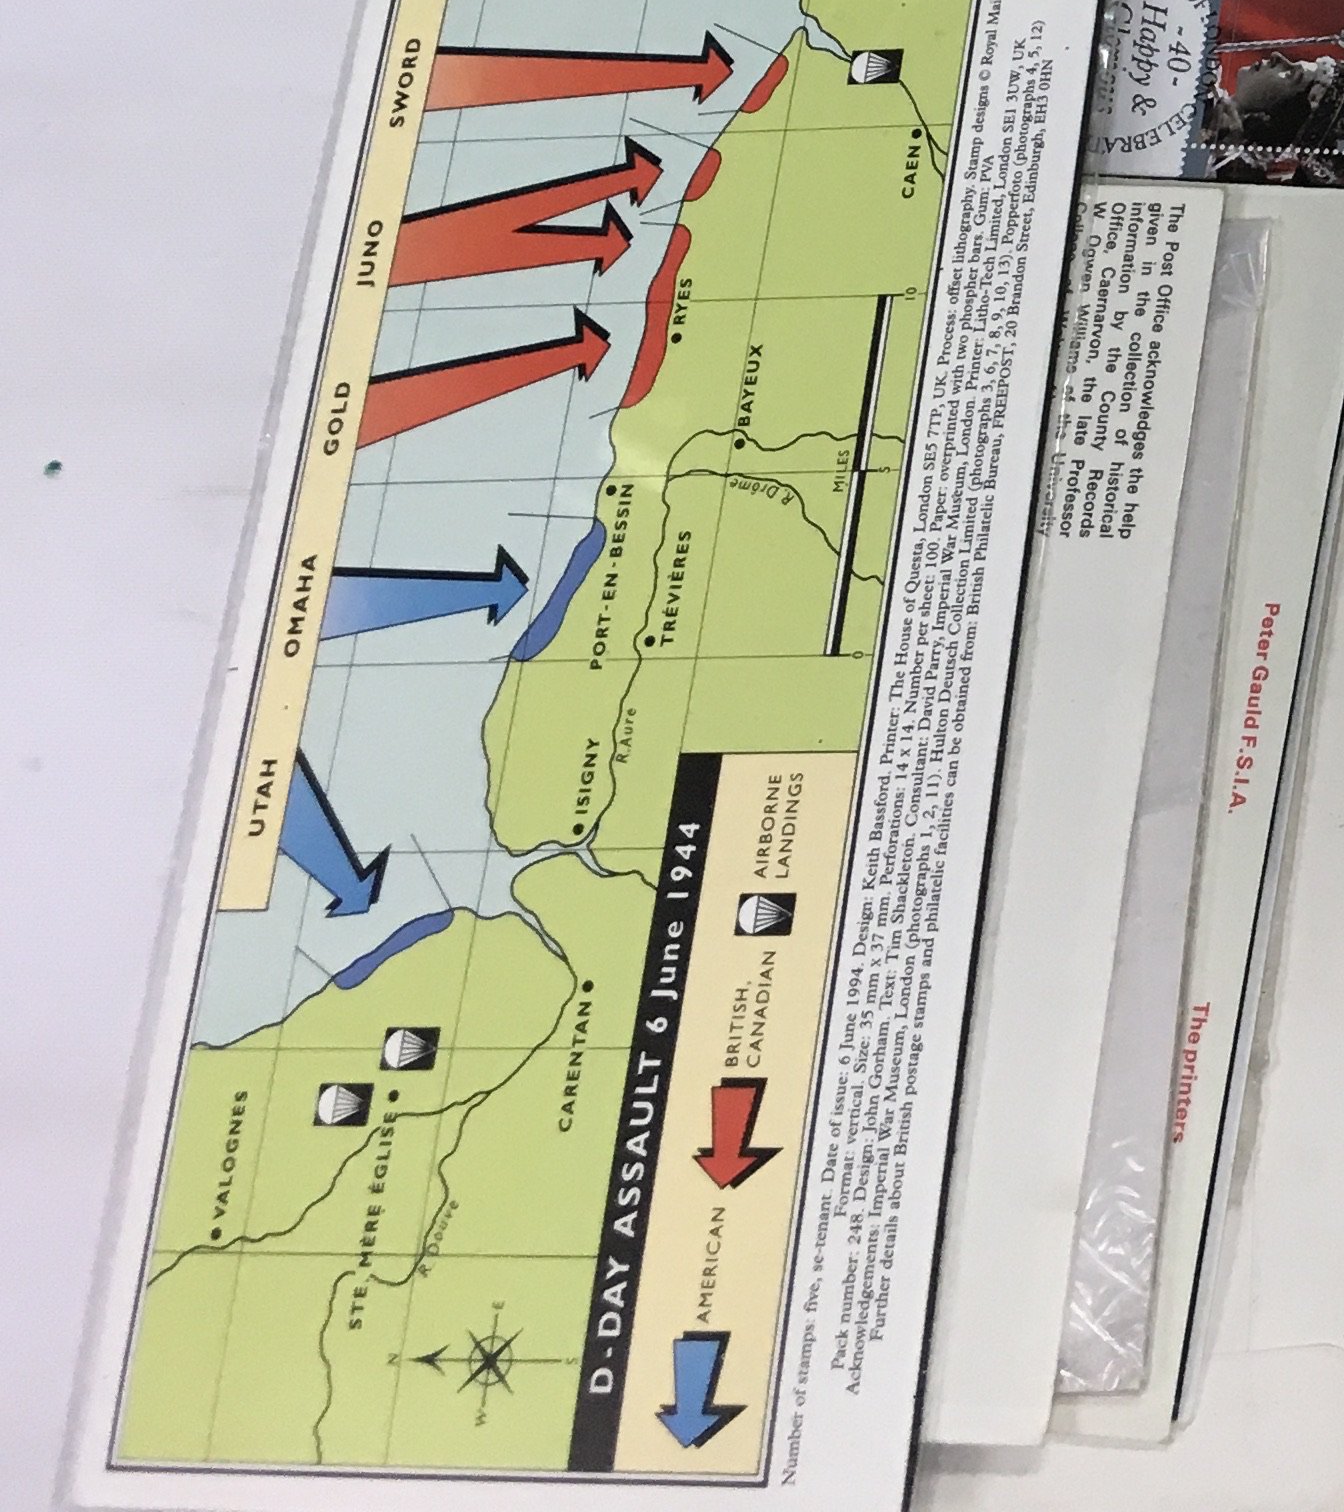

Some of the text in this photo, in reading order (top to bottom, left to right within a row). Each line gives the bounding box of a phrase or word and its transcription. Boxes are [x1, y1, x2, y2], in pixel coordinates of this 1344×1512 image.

[389, 38, 421, 128] SWORD
[901, 145, 921, 198] CAEN
[356, 219, 384, 287] JUNO
[672, 277, 692, 325] RYES
[324, 381, 351, 458] GOLD
[738, 344, 763, 427] BAYEUX
[283, 553, 318, 658] OMAHA
[659, 529, 692, 647] TRÉVIÈRES
[1227, 602, 1282, 815] Peter Gauld F.S.I.A.
[248, 758, 279, 837] UTAH
[574, 737, 600, 814] ISIGNY
[753, 774, 783, 879] AIRBORNE
[774, 771, 804, 879] LANDINGS
[724, 980, 753, 1067] BRITISH,
[746, 950, 777, 1068] CANADIAN
[557, 1001, 593, 1133] CARENTAN
[589, 822, 701, 1395] D-DAY ASSAULT 6 June 1944
[1172, 1001, 1212, 1144] The printers
[213, 1090, 247, 1221] VALOGNES
[358, 1203, 382, 1269] MÈRE
[370, 1110, 400, 1196] ÉGLISE
[696, 1204, 729, 1324] AMERICAN
